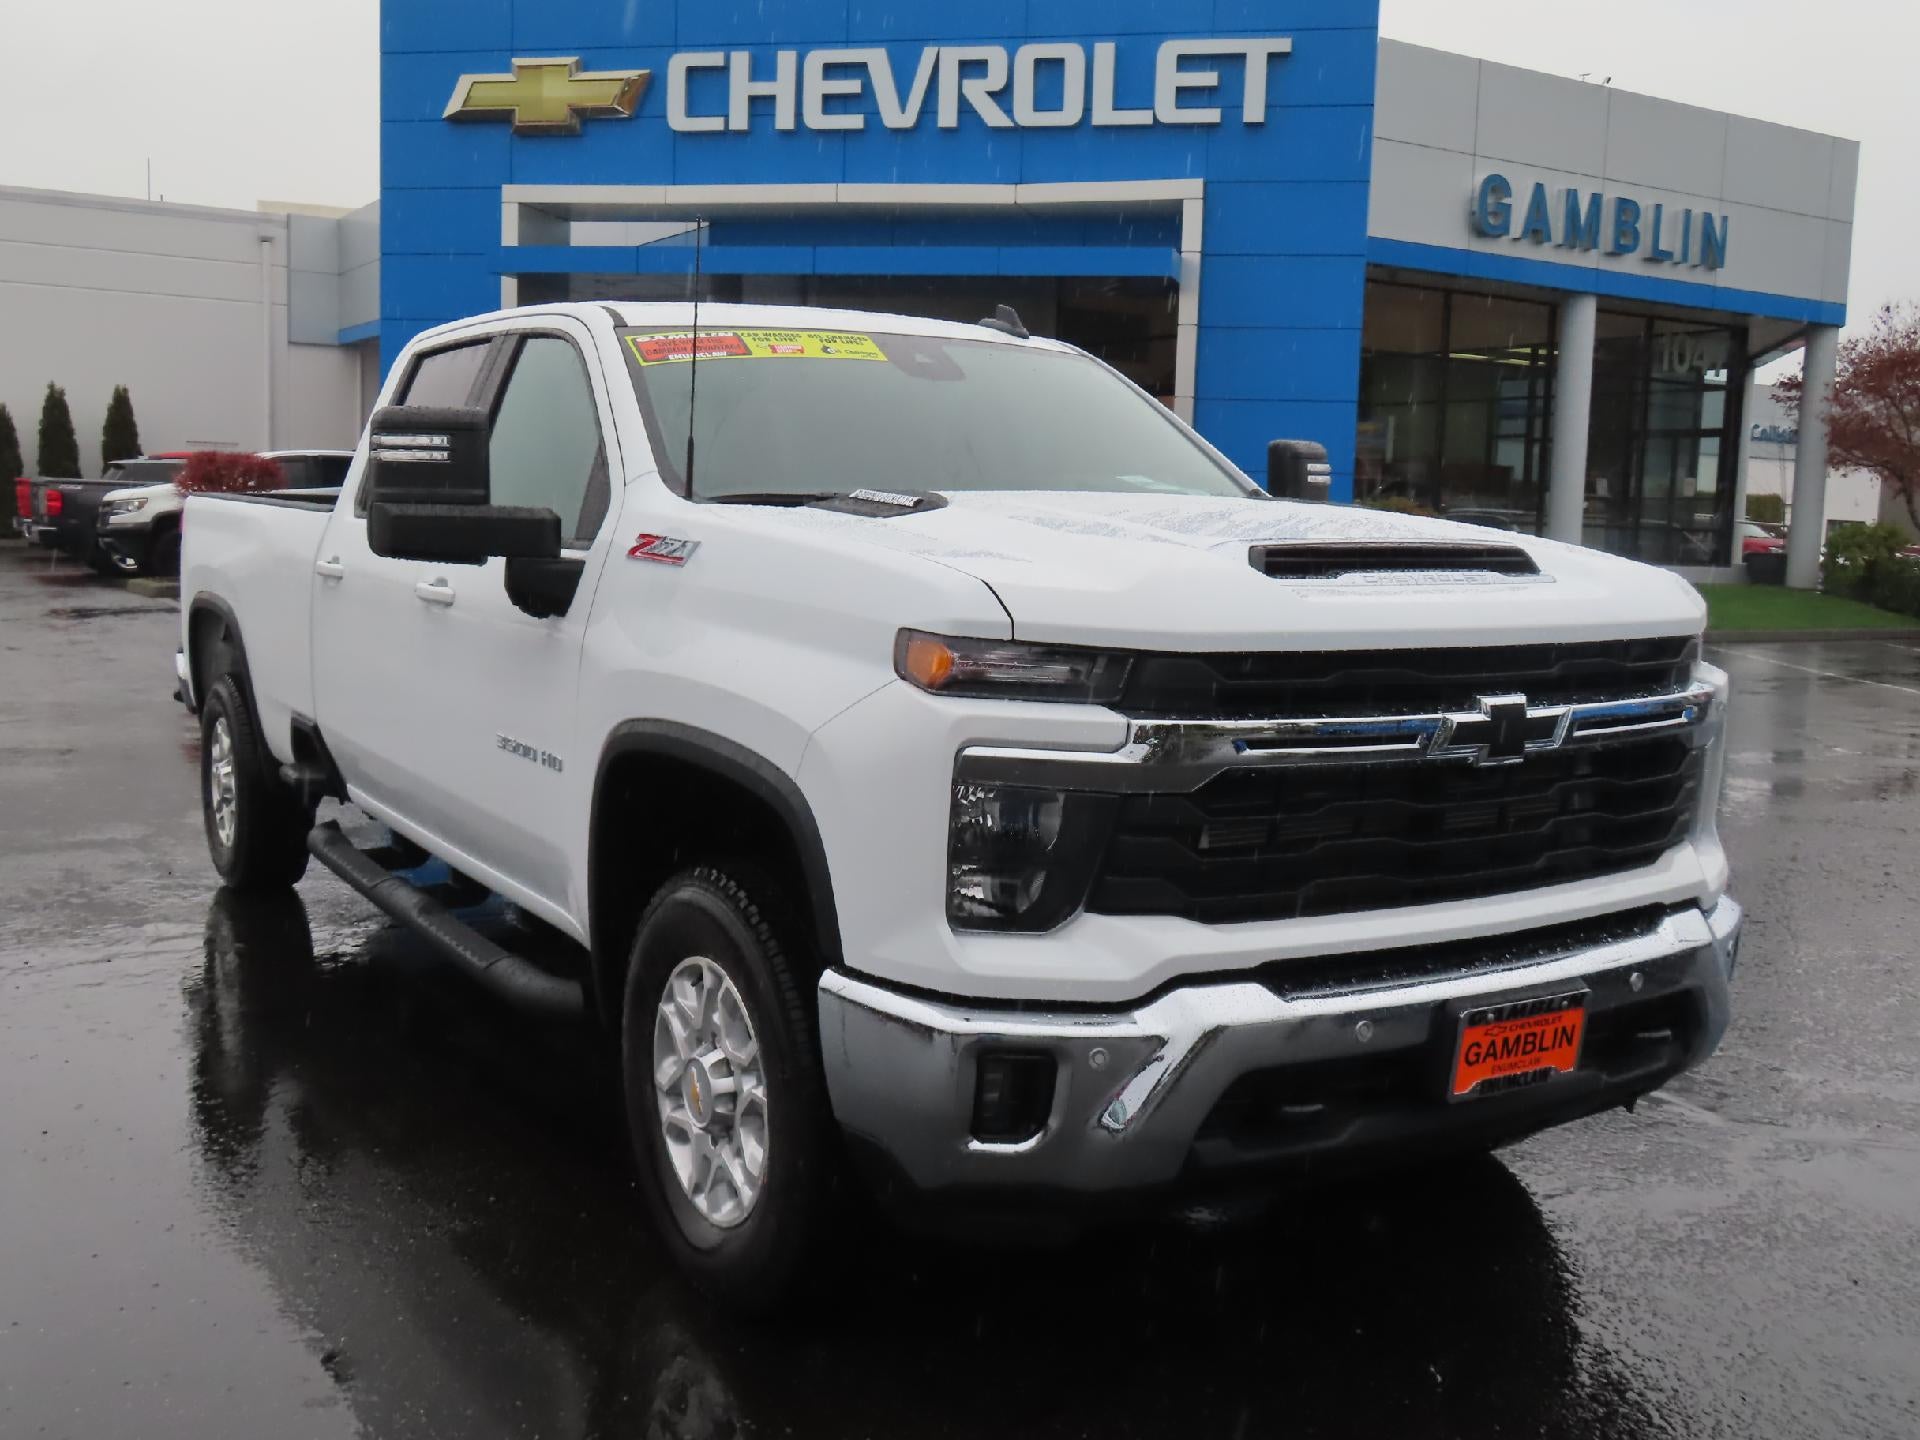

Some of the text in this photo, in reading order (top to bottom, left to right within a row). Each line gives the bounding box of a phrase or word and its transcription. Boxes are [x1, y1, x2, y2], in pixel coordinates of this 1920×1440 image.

[666, 37, 1292, 133] CHEVROLET
[1472, 173, 1729, 269] GAMBLIN
[541, 751, 563, 773] HD
[1508, 1015, 1563, 1032] CHEVROLET
[1464, 1025, 1576, 1067] GAMBLIN
